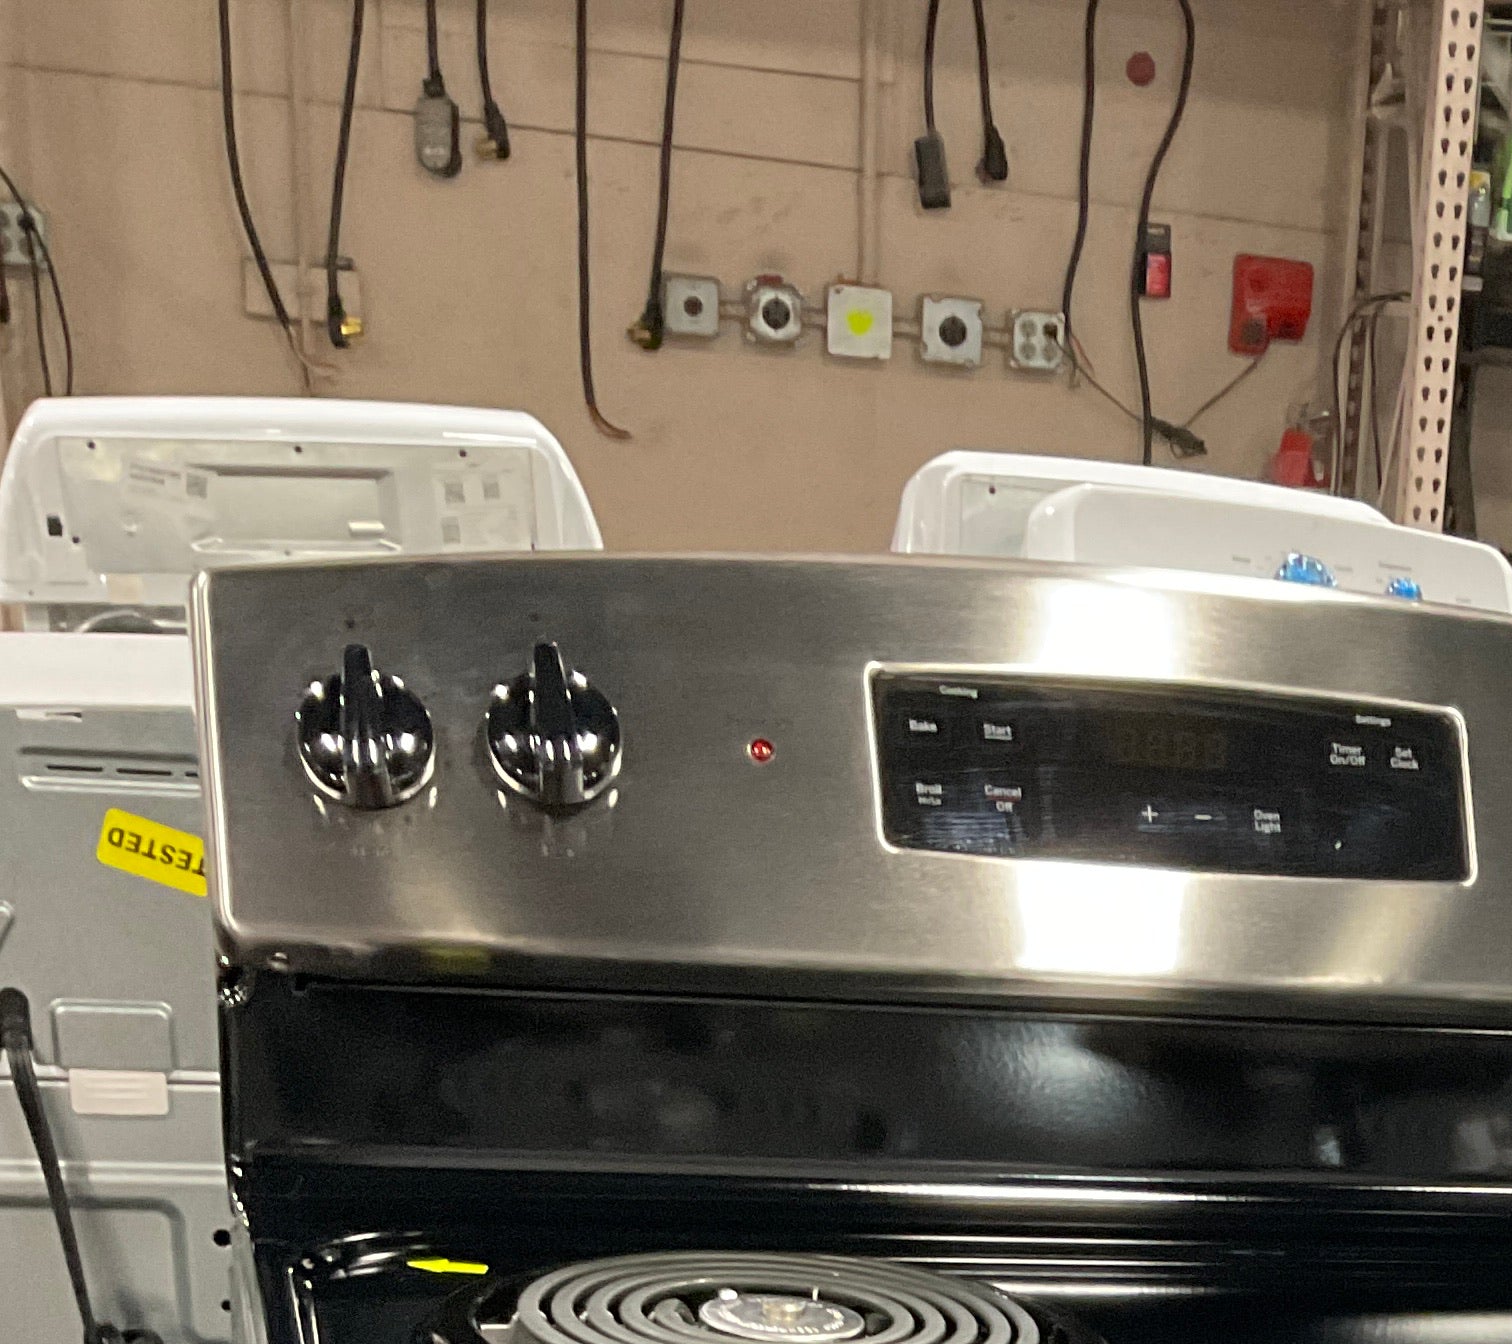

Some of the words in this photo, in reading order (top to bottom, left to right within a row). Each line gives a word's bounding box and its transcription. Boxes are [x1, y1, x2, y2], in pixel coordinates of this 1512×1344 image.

[909, 718, 938, 733] Bake
[983, 722, 1013, 738] Start
[1331, 742, 1362, 754] Timer
[1330, 753, 1366, 767] On/Off
[984, 783, 1022, 799] Cancel
[996, 800, 1013, 813] Off
[1254, 808, 1280, 821] Oven
[1254, 820, 1281, 834] Light
[107, 827, 205, 877] TESTED
